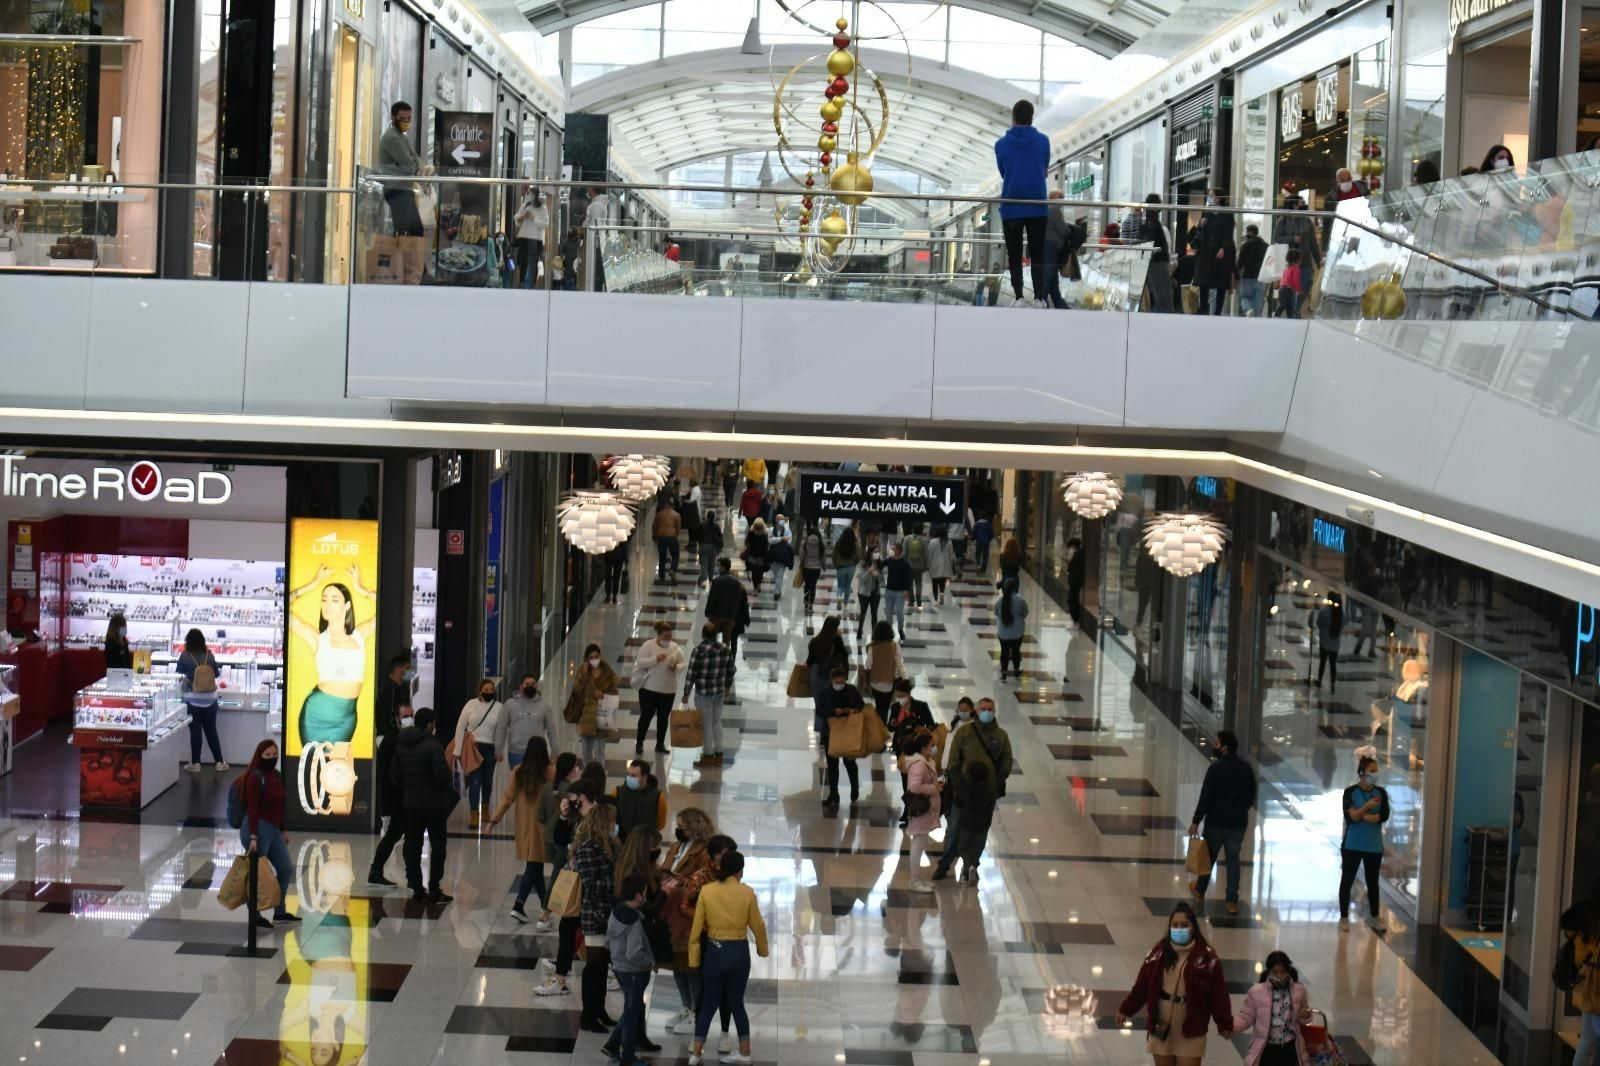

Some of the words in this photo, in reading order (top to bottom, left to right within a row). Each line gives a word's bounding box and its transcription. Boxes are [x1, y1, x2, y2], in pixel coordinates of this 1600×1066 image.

[451, 124, 483, 142] Charlotte
[0, 454, 87, 499] Time
[813, 482, 862, 496] PLAZA
[867, 484, 938, 499] CENTRAL
[821, 499, 859, 512] PLAZA
[861, 502, 927, 514] ALHAMBRA
[1313, 518, 1345, 553] PRIMARK
[312, 543, 359, 556] LOTUS
